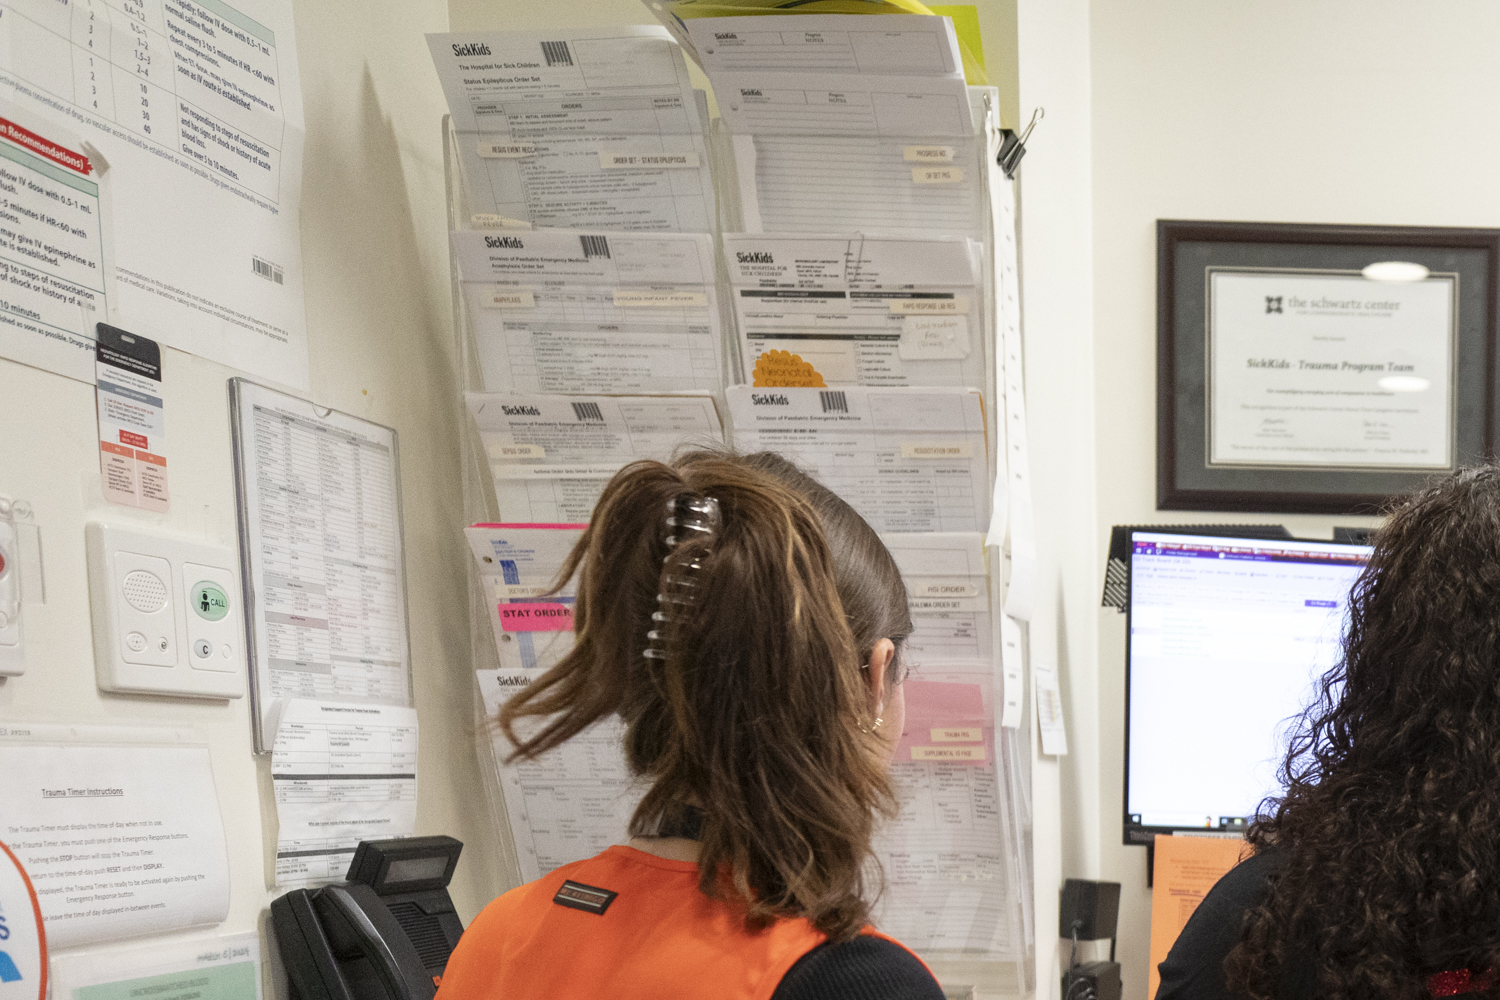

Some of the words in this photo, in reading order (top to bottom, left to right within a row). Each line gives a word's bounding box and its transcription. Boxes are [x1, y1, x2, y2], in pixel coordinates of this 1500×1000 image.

[167, 20, 186, 39] Repeat
[187, 31, 201, 46] every
[217, 48, 238, 65] minutes
[263, 74, 275, 86] with
[452, 43, 491, 57] SickKids
[471, 63, 493, 71] Hospital
[482, 77, 512, 85] Epilepticus
[180, 103, 189, 114] Not
[190, 108, 215, 132] responding
[222, 125, 233, 140] steps
[240, 136, 269, 158] resuscitation
[8, 126, 84, 170] Recommendations)
[28, 181, 44, 194] dose
[45, 189, 60, 201] with
[61, 196, 78, 208] 0.5-1
[80, 204, 91, 214] mL
[10, 202, 38, 220] minutes
[71, 226, 87, 239] with
[484, 236, 523, 249] SickKids
[18, 234, 33, 245] give
[35, 239, 42, 248] IV
[44, 244, 86, 265] epinephrine
[17, 246, 60, 267] established.
[737, 252, 773, 264] SickKids
[21, 268, 39, 281] steps
[50, 280, 94, 300] resuscitation
[1289, 296, 1307, 307] the
[1311, 296, 1361, 309] schwartz
[1364, 300, 1400, 310] center
[1247, 358, 1290, 369] SickKids
[1298, 360, 1338, 371] Trauma
[1341, 361, 1384, 373] Program
[1387, 362, 1414, 372] Team
[752, 394, 789, 406] SickKids
[501, 405, 540, 416] SickKids
[210, 598, 225, 607] CALL
[535, 609, 570, 617] ORDER
[203, 645, 208, 655] C
[42, 789, 66, 797] Trauma
[67, 788, 86, 797] Timer
[87, 787, 123, 796] Instructions
[29, 857, 49, 865] Pushing
[143, 863, 164, 871] DISPLAY.
